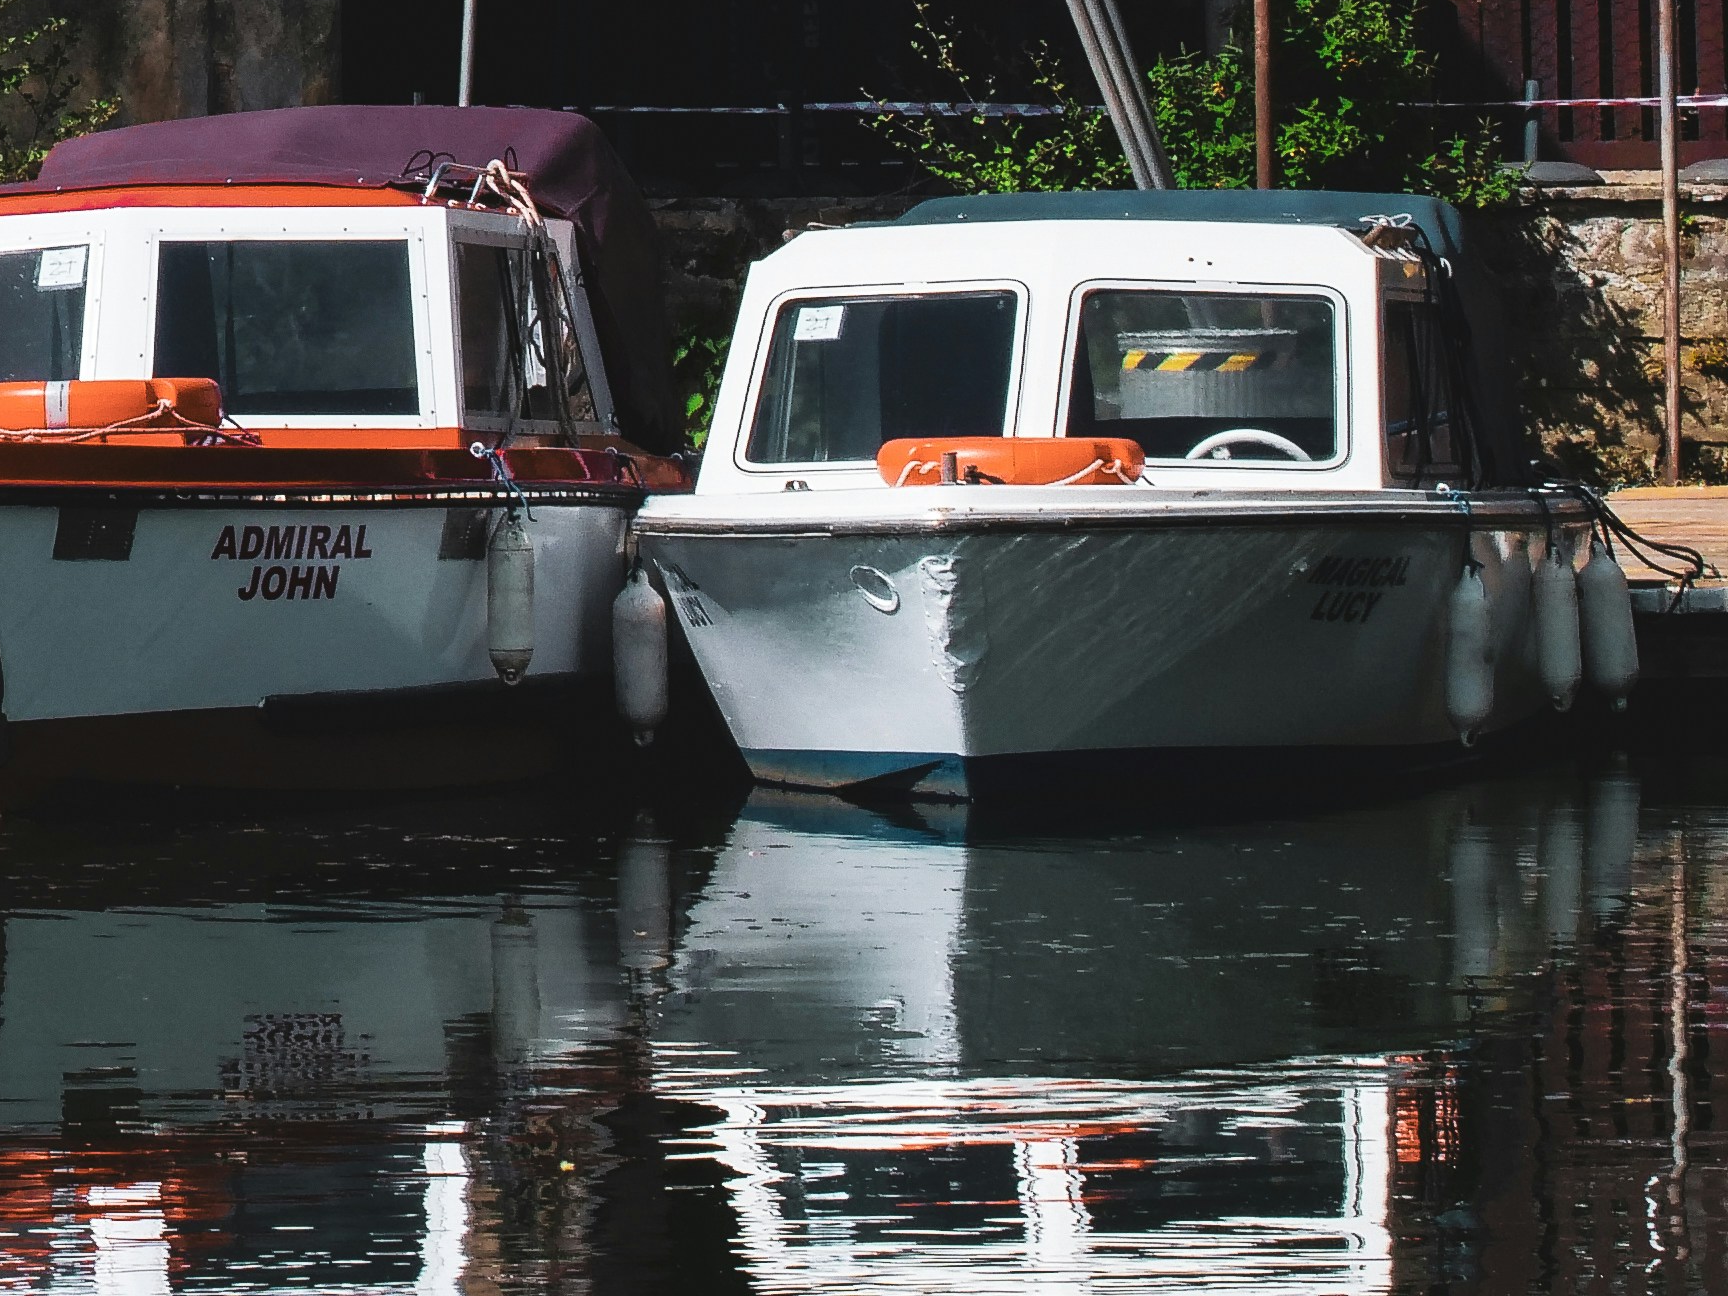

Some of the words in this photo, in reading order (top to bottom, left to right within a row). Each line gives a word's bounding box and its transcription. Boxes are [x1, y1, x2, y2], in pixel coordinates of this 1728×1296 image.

[209, 523, 374, 562] ADMIRAL
[236, 564, 342, 602] JOHN
[1309, 589, 1384, 624] LUCY
